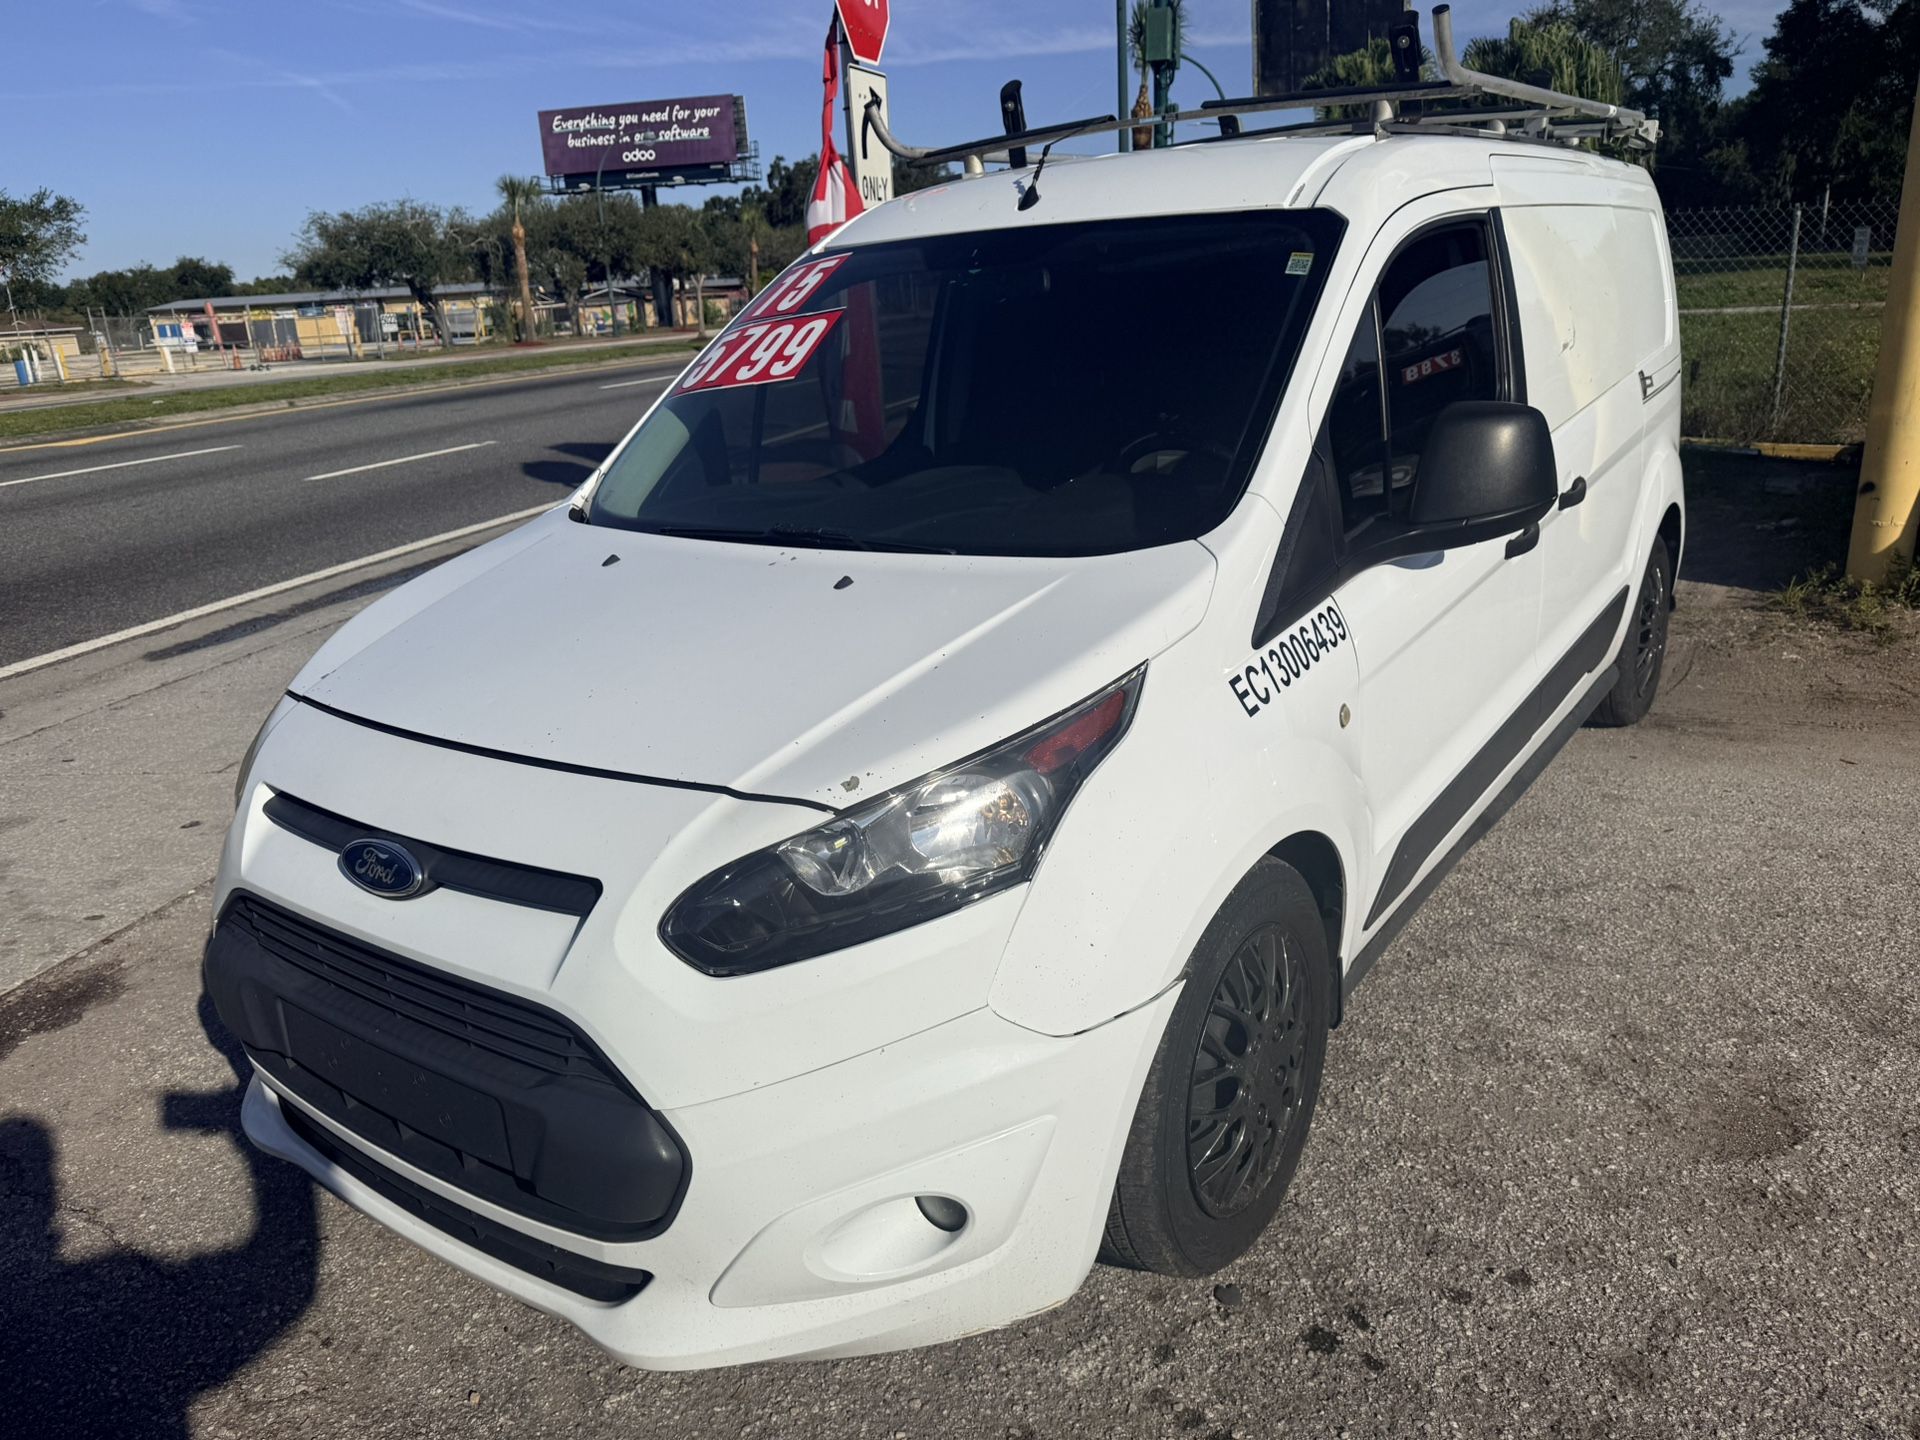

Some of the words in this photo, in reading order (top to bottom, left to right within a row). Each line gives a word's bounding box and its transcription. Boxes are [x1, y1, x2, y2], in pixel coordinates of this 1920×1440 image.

[552, 112, 616, 132] Everything
[618, 113, 638, 129] you
[642, 106, 669, 122] need
[672, 105, 690, 121] for
[692, 106, 720, 123] your
[567, 133, 615, 148] business
[618, 131, 630, 144] in
[659, 124, 710, 141] software
[622, 148, 656, 162] odoo
[862, 175, 888, 201] ONLY
[752, 258, 841, 317] 15
[682, 318, 828, 388] 5799
[1228, 606, 1347, 718] EC13006439
[355, 847, 398, 884] Ford
